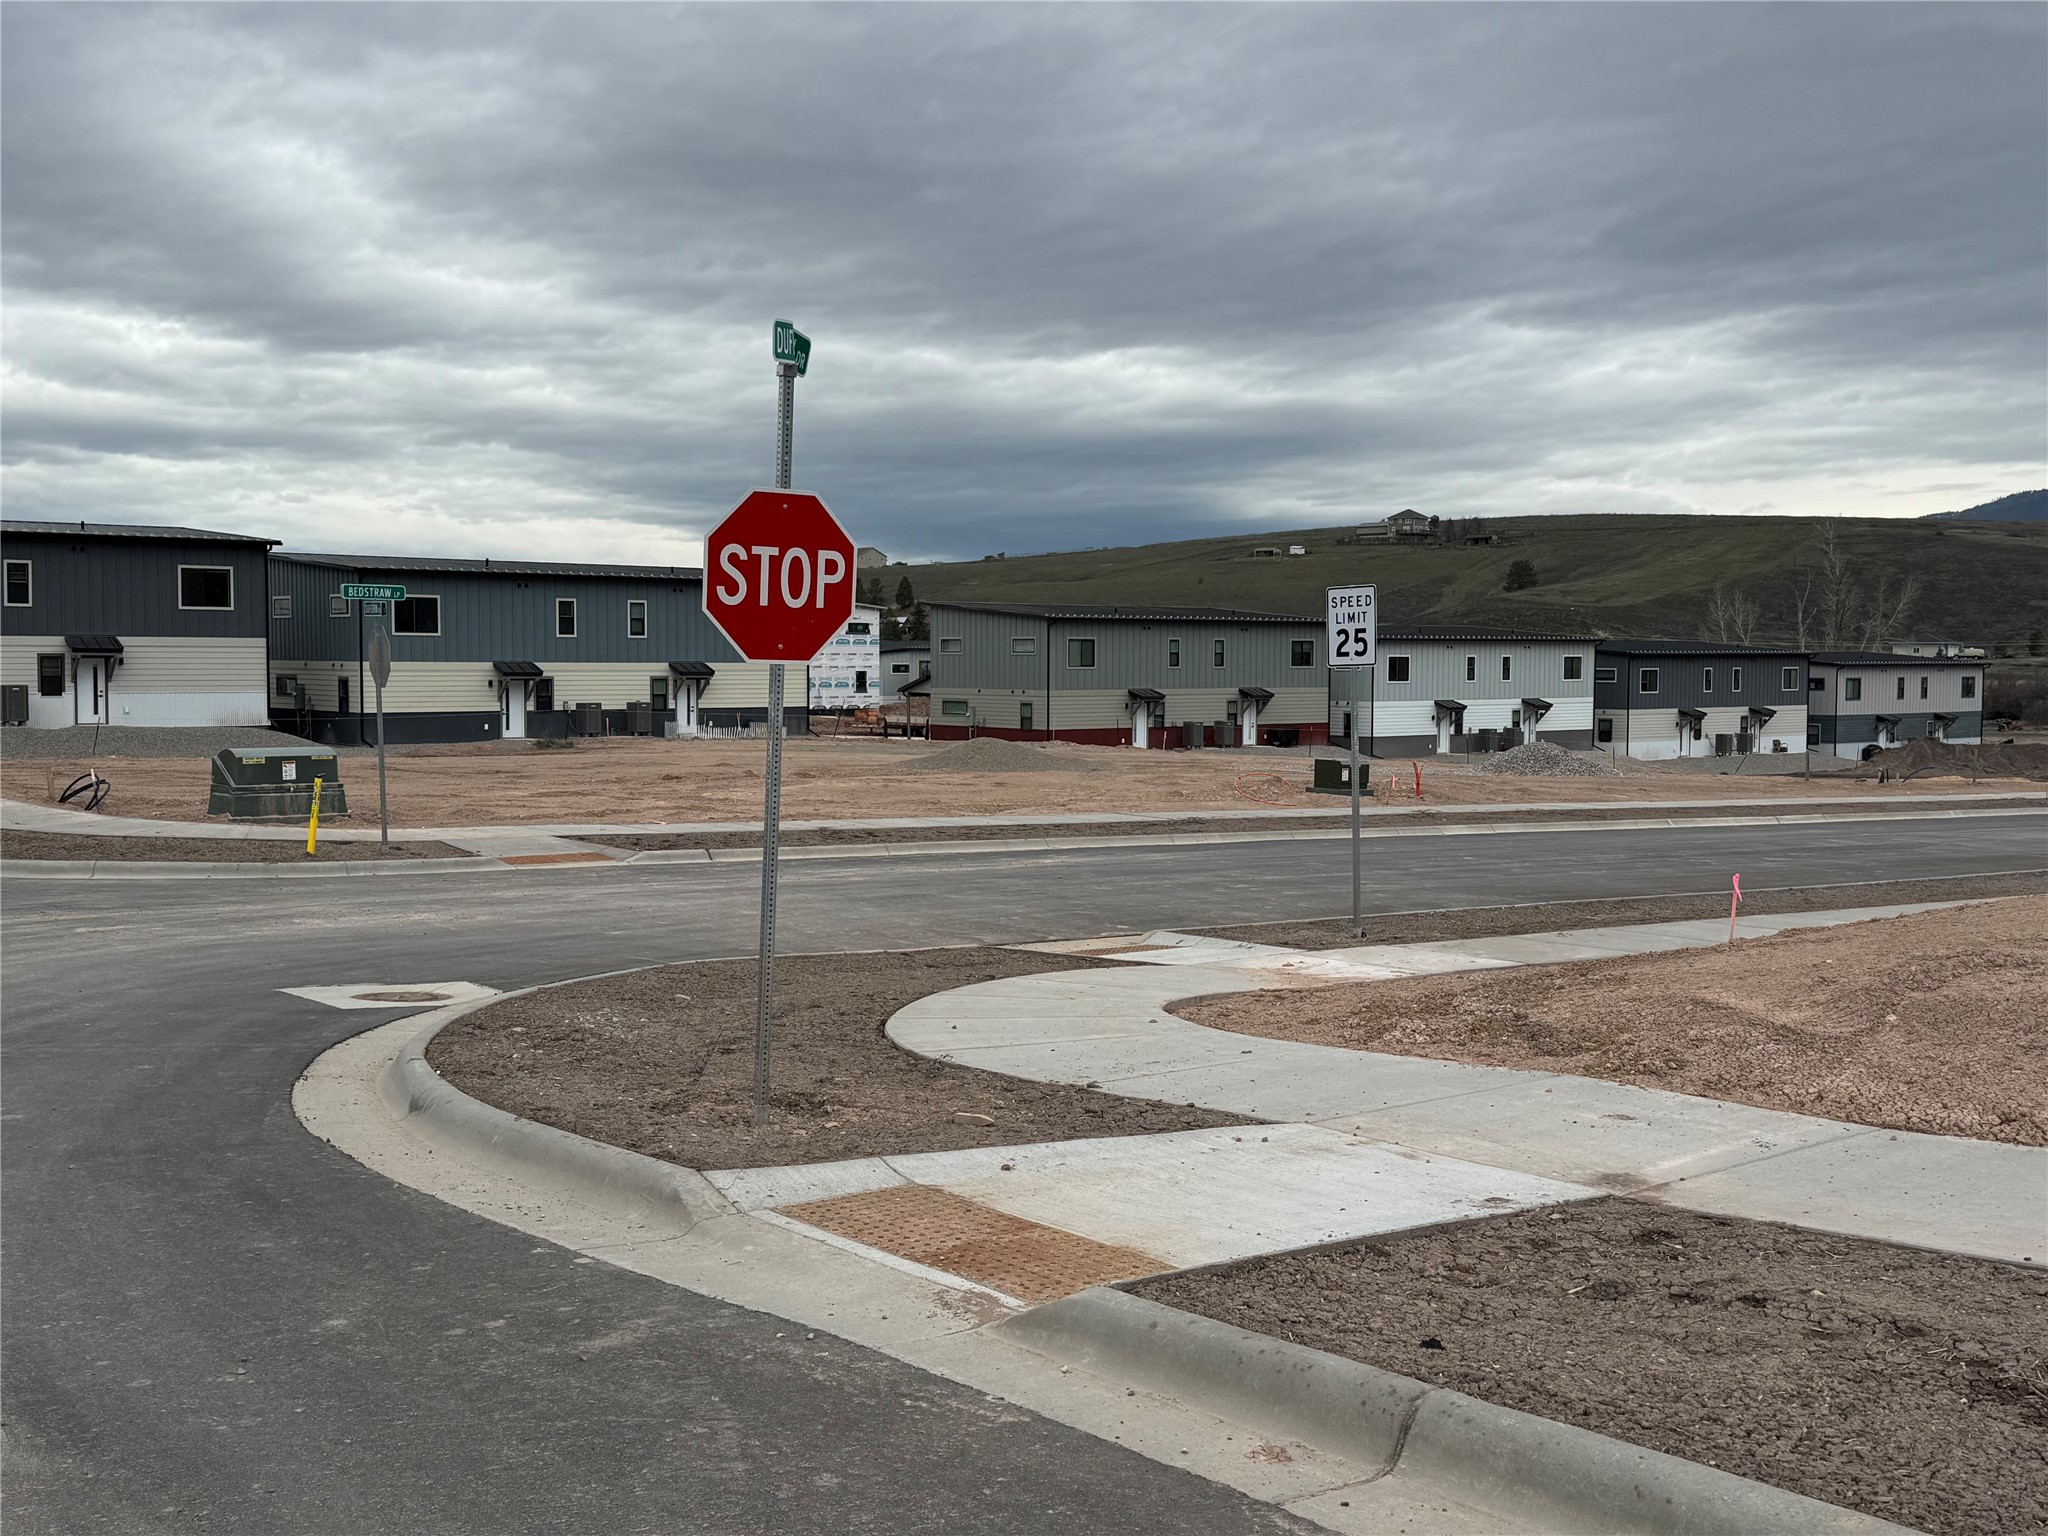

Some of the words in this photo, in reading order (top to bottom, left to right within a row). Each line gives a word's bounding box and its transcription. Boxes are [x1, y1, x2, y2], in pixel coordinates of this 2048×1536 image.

[795, 350, 806, 370] DR
[716, 543, 846, 609] STOP
[348, 587, 392, 598] BEDSTRAW
[1331, 594, 1373, 609] SPEED
[1336, 611, 1368, 624] LIMIT
[1336, 628, 1368, 657] 25
